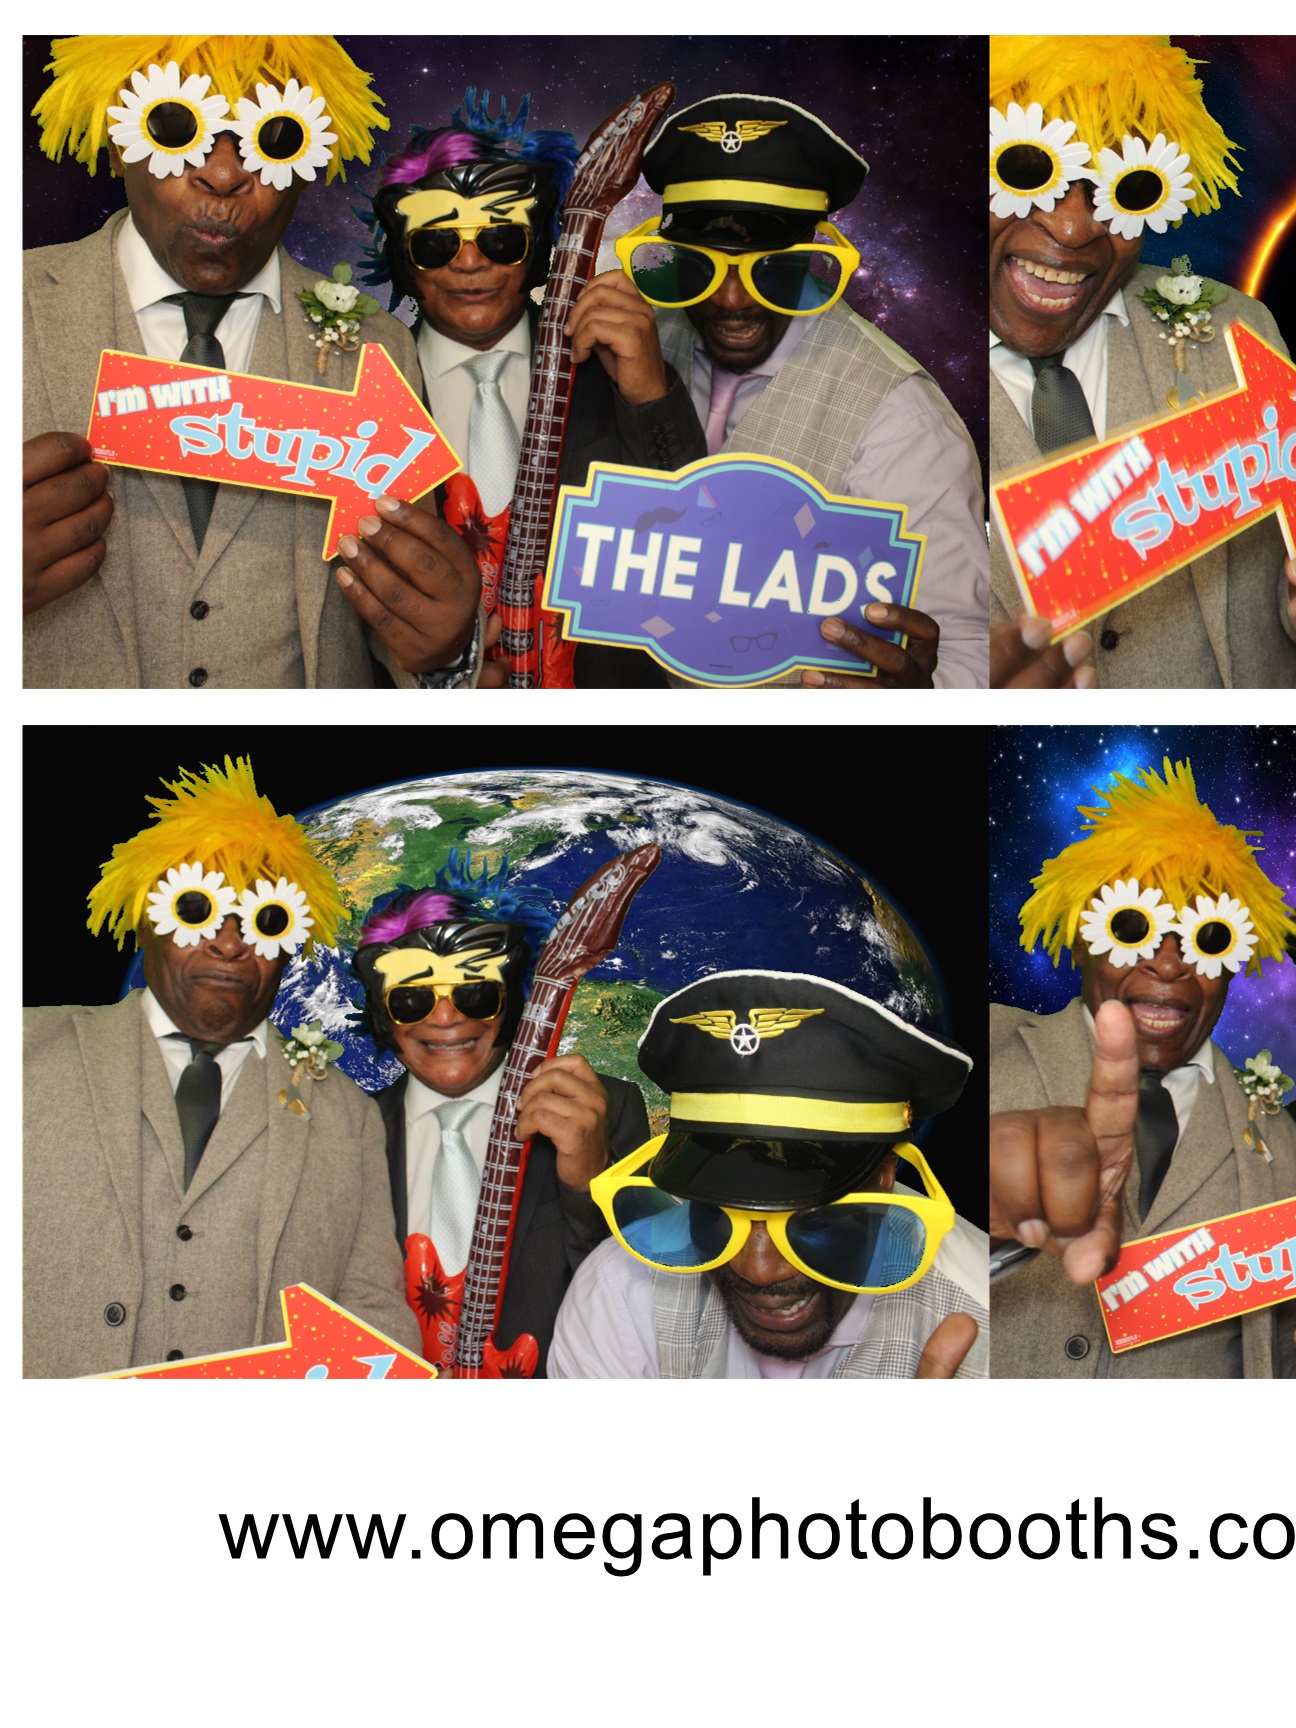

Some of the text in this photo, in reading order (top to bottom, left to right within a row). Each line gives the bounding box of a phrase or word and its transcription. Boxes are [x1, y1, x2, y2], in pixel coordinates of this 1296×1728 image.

[149, 375, 231, 409] WITH
[169, 402, 436, 499] stupid
[1069, 434, 1154, 524] WITH
[576, 521, 898, 617] THE LADS
[1142, 1226, 1216, 1282] WITH
